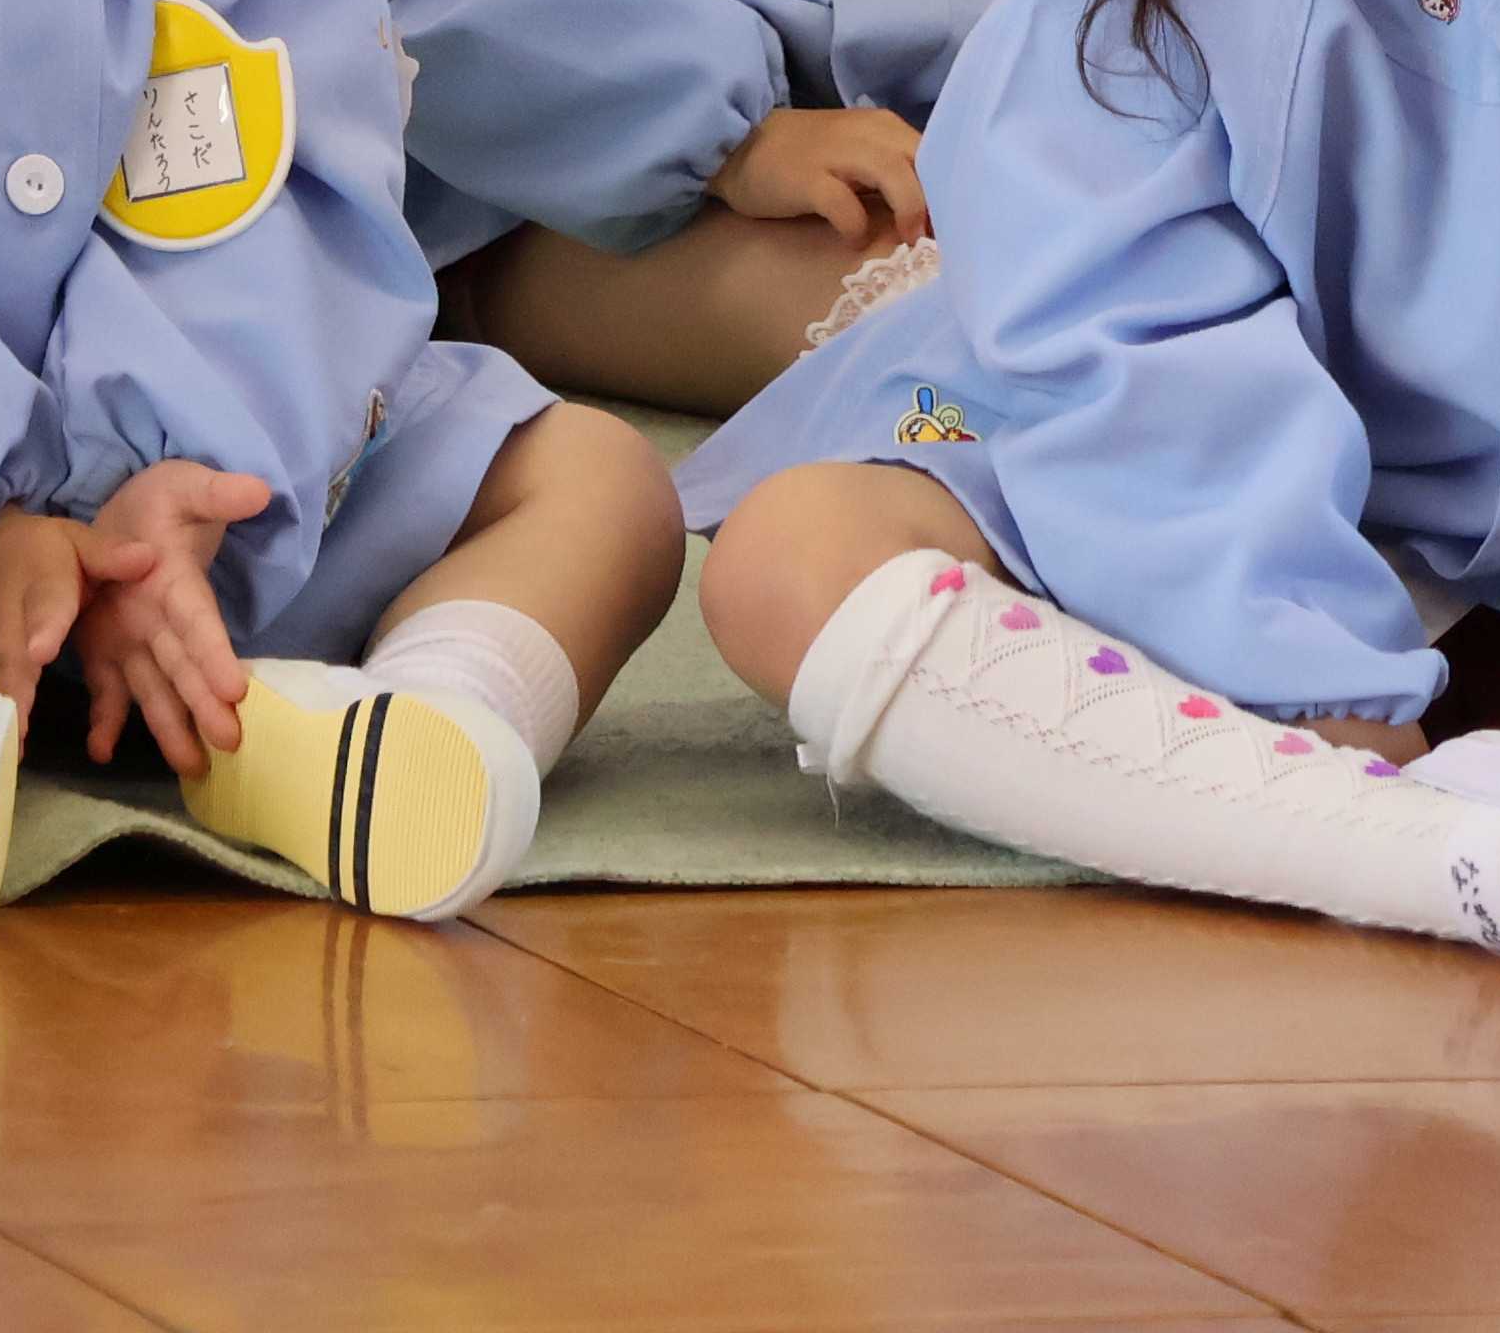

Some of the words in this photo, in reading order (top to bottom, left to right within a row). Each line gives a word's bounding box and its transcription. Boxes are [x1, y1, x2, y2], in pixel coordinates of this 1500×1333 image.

[143, 89, 171, 191] りんたろう
[184, 90, 213, 170] さこだ
